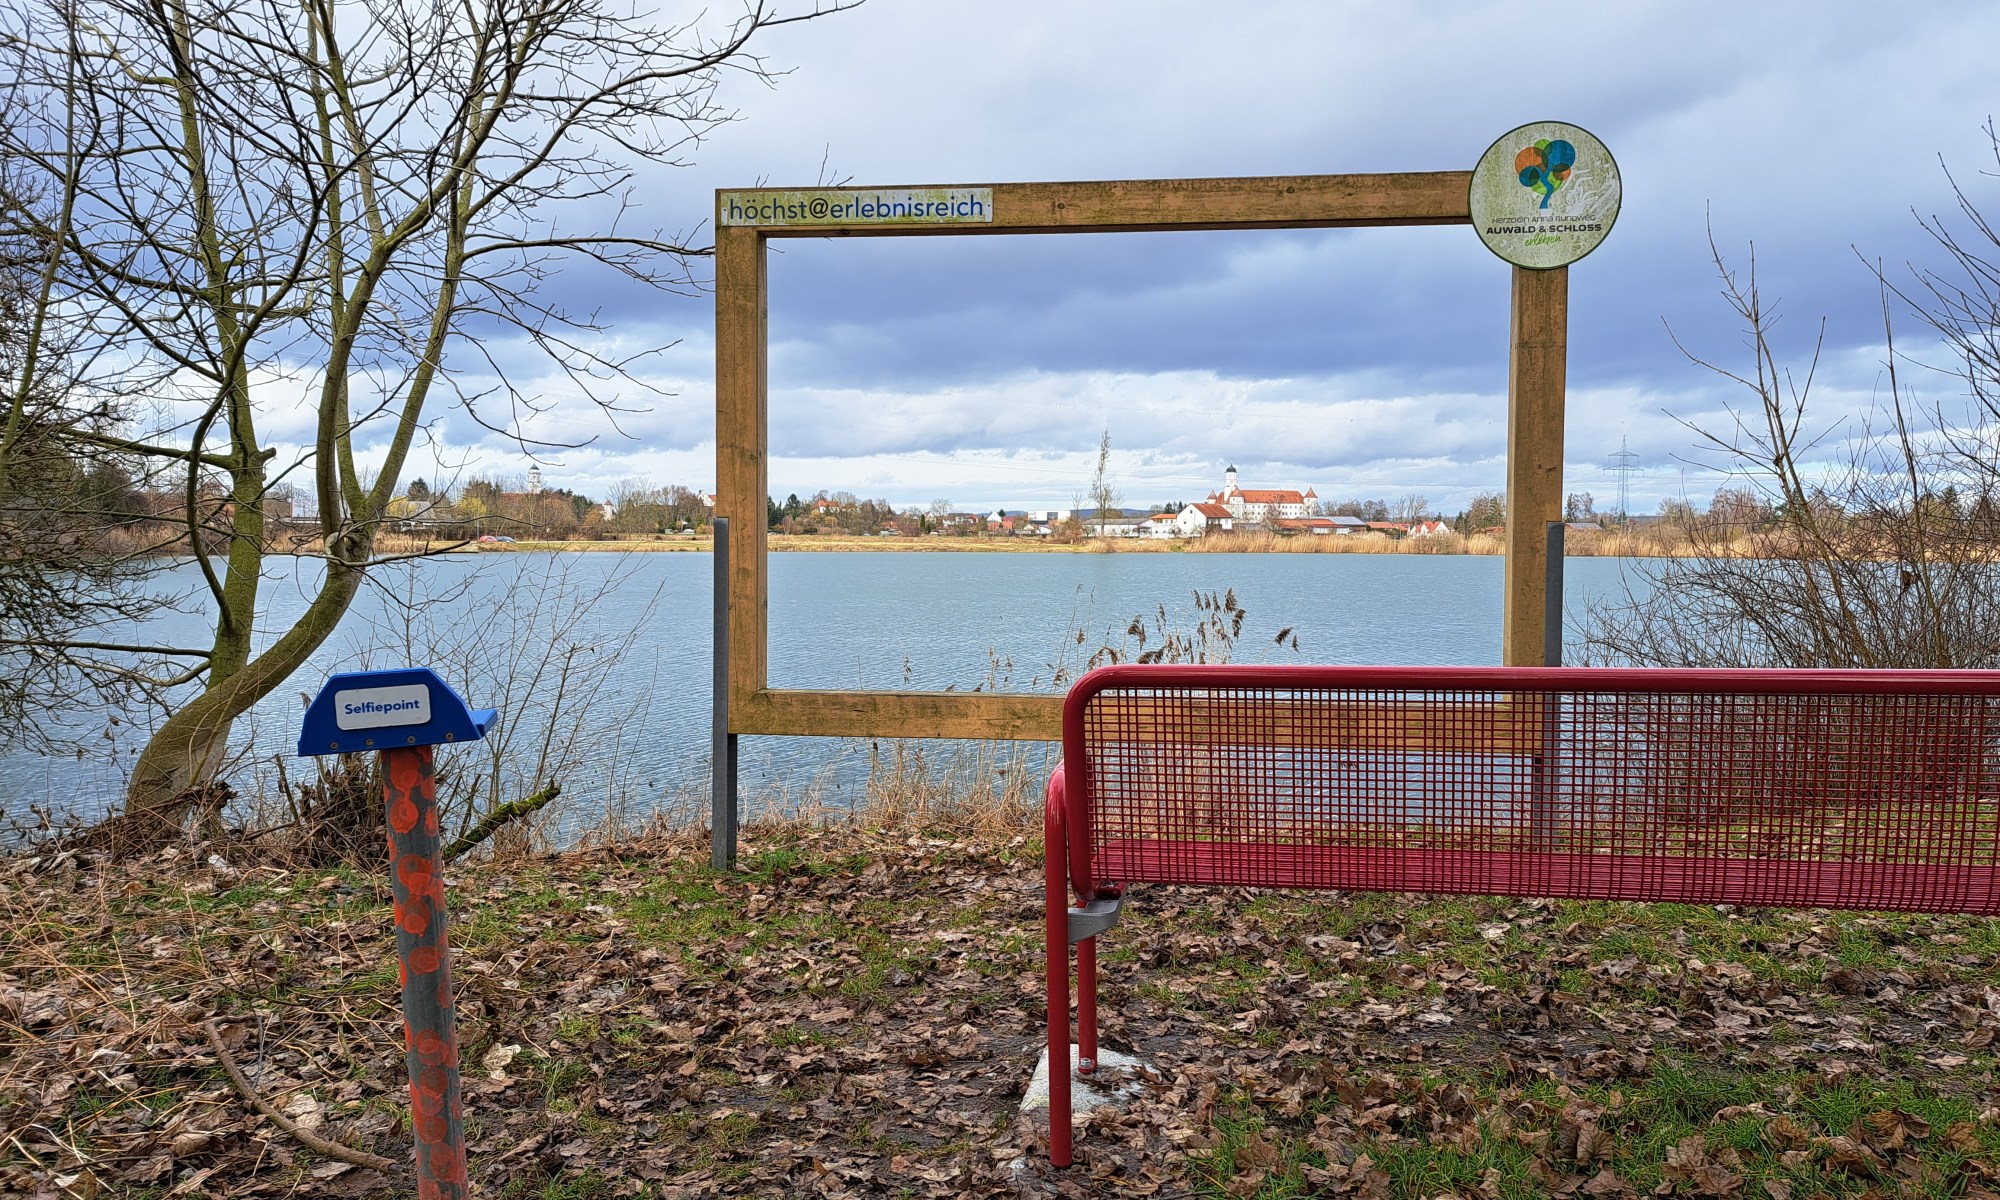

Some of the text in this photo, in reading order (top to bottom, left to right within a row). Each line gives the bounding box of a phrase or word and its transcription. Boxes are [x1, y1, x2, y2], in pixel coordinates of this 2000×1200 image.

[729, 194, 983, 219] höchst@erlebnisreich
[1539, 225, 1546, 233] &
[1548, 223, 1602, 233] SCHLOSS
[344, 699, 420, 715] Selfiepoint
